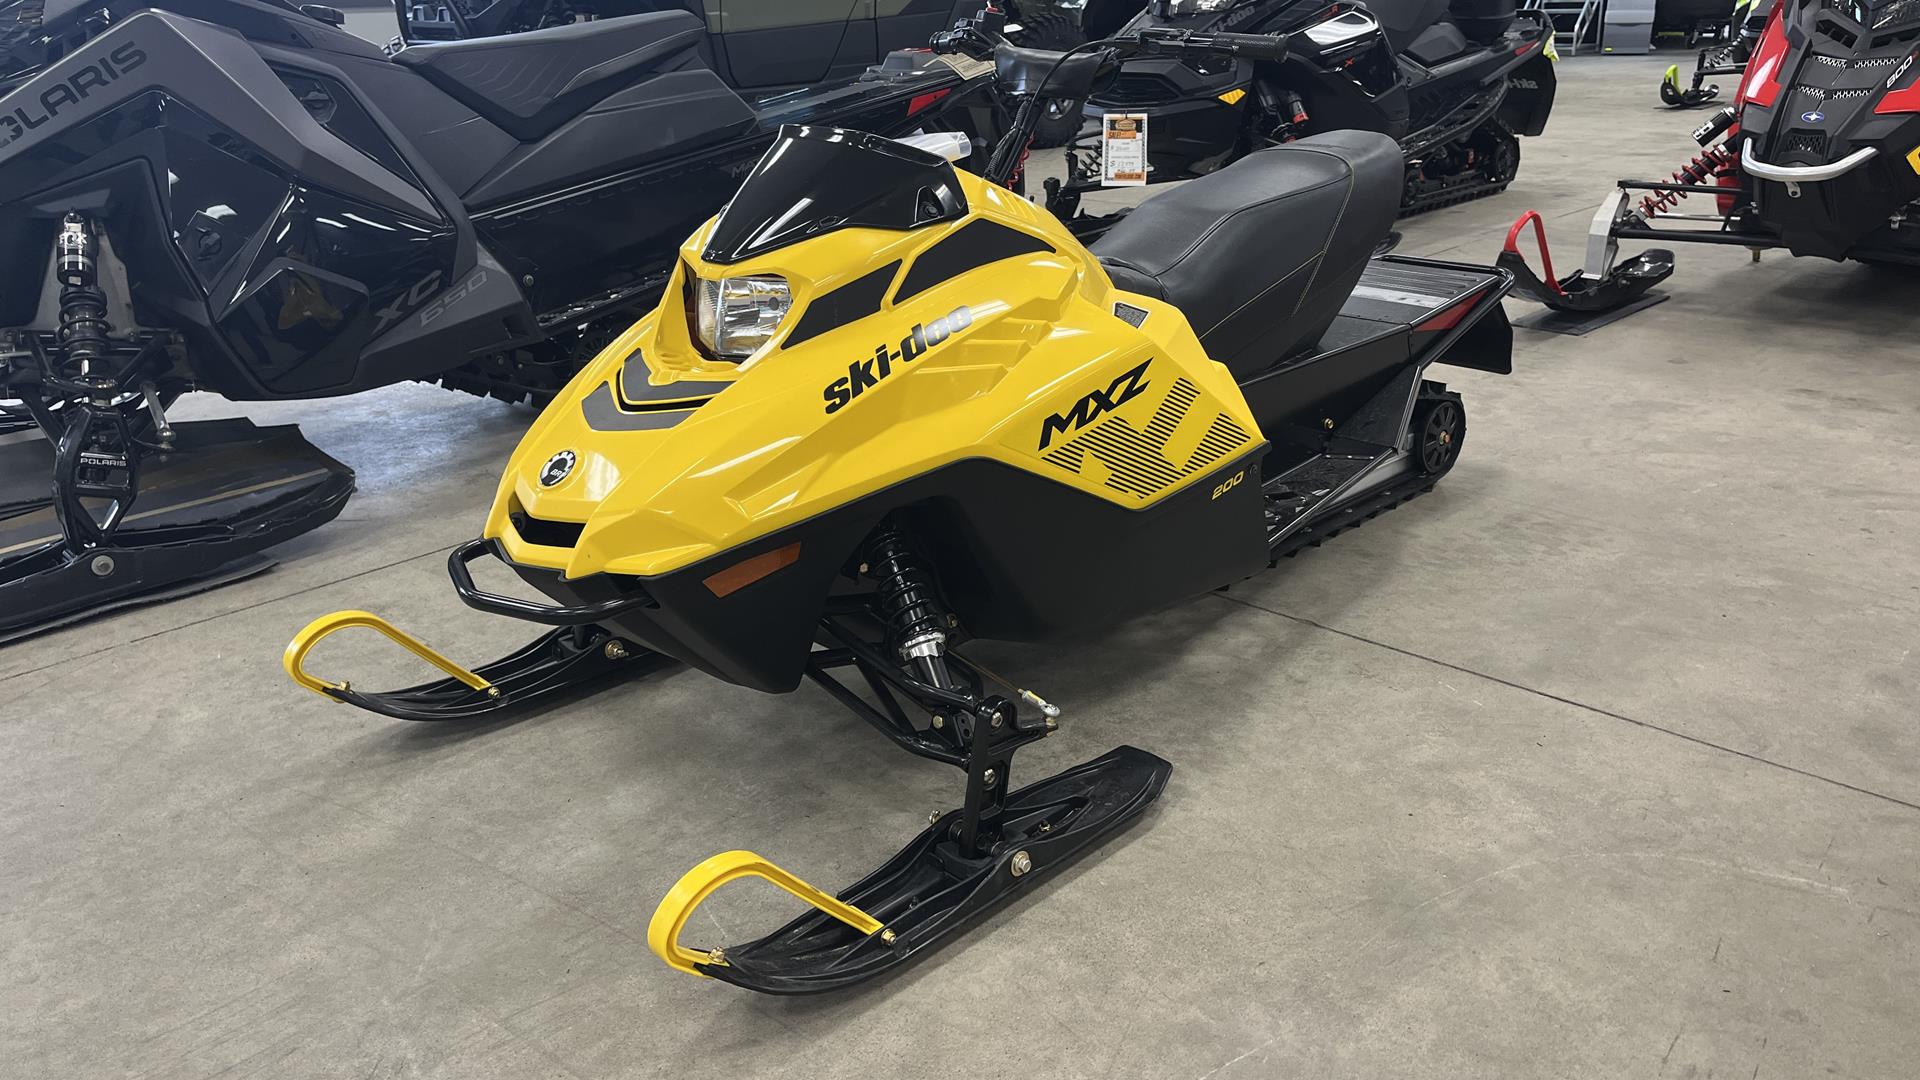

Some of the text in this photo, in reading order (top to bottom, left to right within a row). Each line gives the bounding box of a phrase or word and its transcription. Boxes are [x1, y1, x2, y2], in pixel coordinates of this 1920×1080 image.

[1207, 4, 1257, 34] ki-doo
[1886, 55, 1913, 89] 800
[370, 269, 442, 336] XC
[420, 270, 488, 328] 650
[823, 305, 973, 415] ski-doo
[1038, 356, 1154, 452] MXZ
[80, 457, 127, 467] POLARIS
[1211, 470, 1245, 501] 200
